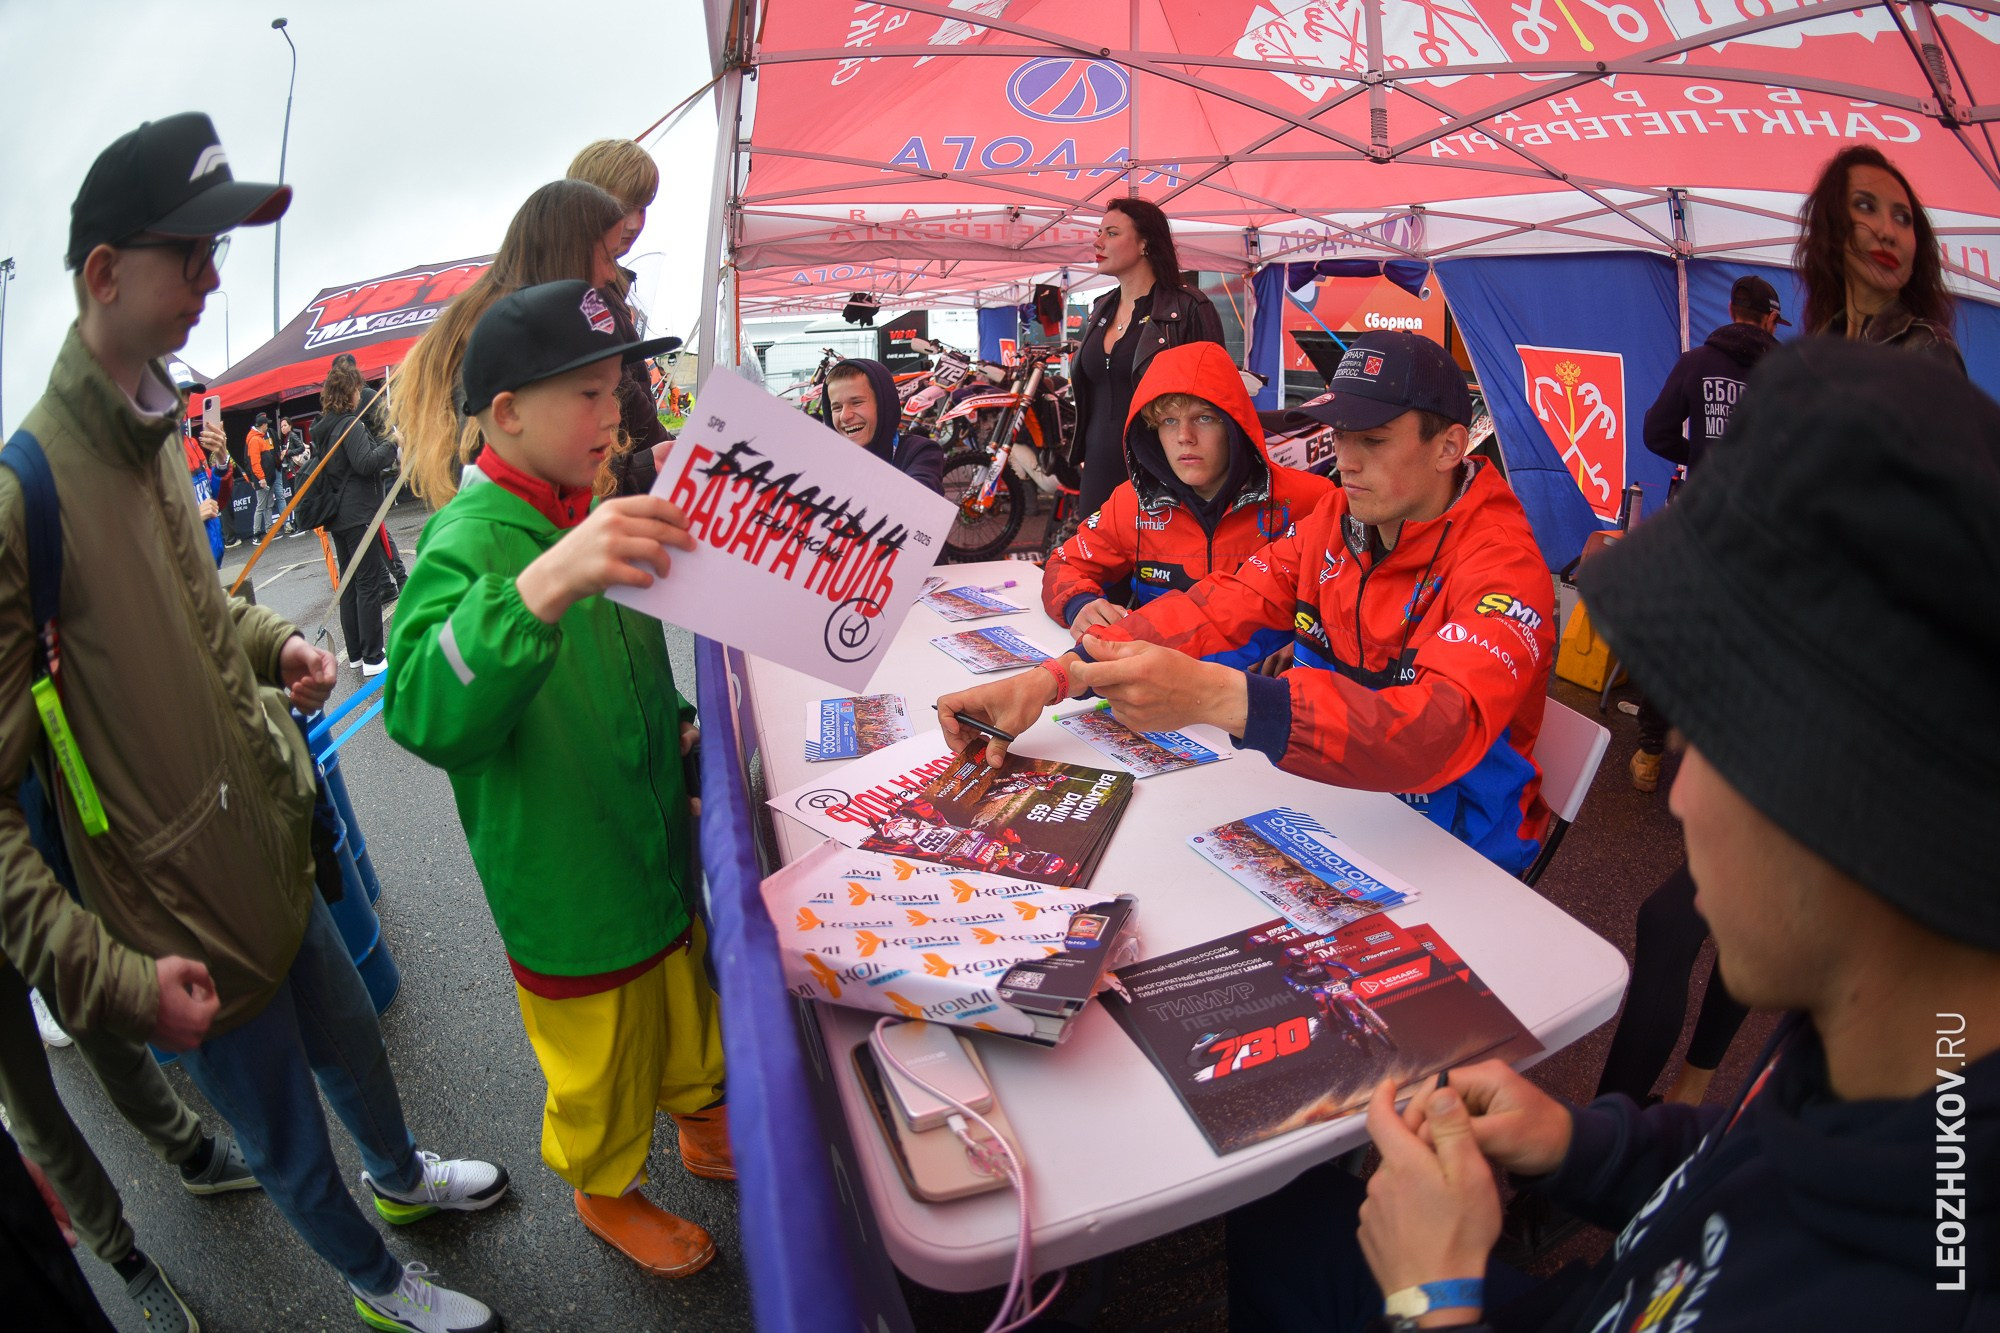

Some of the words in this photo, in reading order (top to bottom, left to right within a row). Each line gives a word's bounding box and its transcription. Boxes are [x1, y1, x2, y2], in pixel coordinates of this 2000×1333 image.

[1364, 313, 1423, 330] Сборная
[935, 361, 963, 382] 772
[708, 415, 727, 433] SPB
[669, 443, 814, 582] БАЗАРА
[803, 518, 900, 619] НОЛЬ
[753, 509, 793, 538] TEAM
[791, 529, 845, 563] RACING
[913, 530, 933, 547] 2025
[1474, 592, 1543, 629] SMX
[1467, 634, 1518, 680] ЛАДОГА
[822, 702, 835, 754] МОТОКРОСС
[1026, 803, 1052, 823] 655
[1045, 791, 1081, 823] DANIIL
[1068, 773, 1116, 822] BALANDIN
[1270, 817, 1384, 892] МОТОКРОСС
[871, 893, 939, 902] KOMI
[975, 884, 1043, 898] KOMI
[820, 920, 893, 928] KOMI
[932, 913, 1004, 924] KOMI
[882, 936, 960, 948] KOMI
[1133, 973, 1195, 993] МНОГОКРАТНЫЙ
[1195, 965, 1231, 979] ЧЕМПИОН
[1231, 957, 1263, 969] РОССИИ
[1136, 988, 1164, 999] ТИМУР
[1164, 978, 1206, 992] ПЕТРАШИН
[1206, 969, 1244, 982] ВЫБИРАЕТ
[1243, 960, 1274, 973] LEMARC
[1379, 967, 1420, 985] LEMARC
[923, 989, 993, 1020] KOMI
[1147, 982, 1255, 1021] ТИМУР
[1180, 990, 1297, 1031] ПЕТРАШИН
